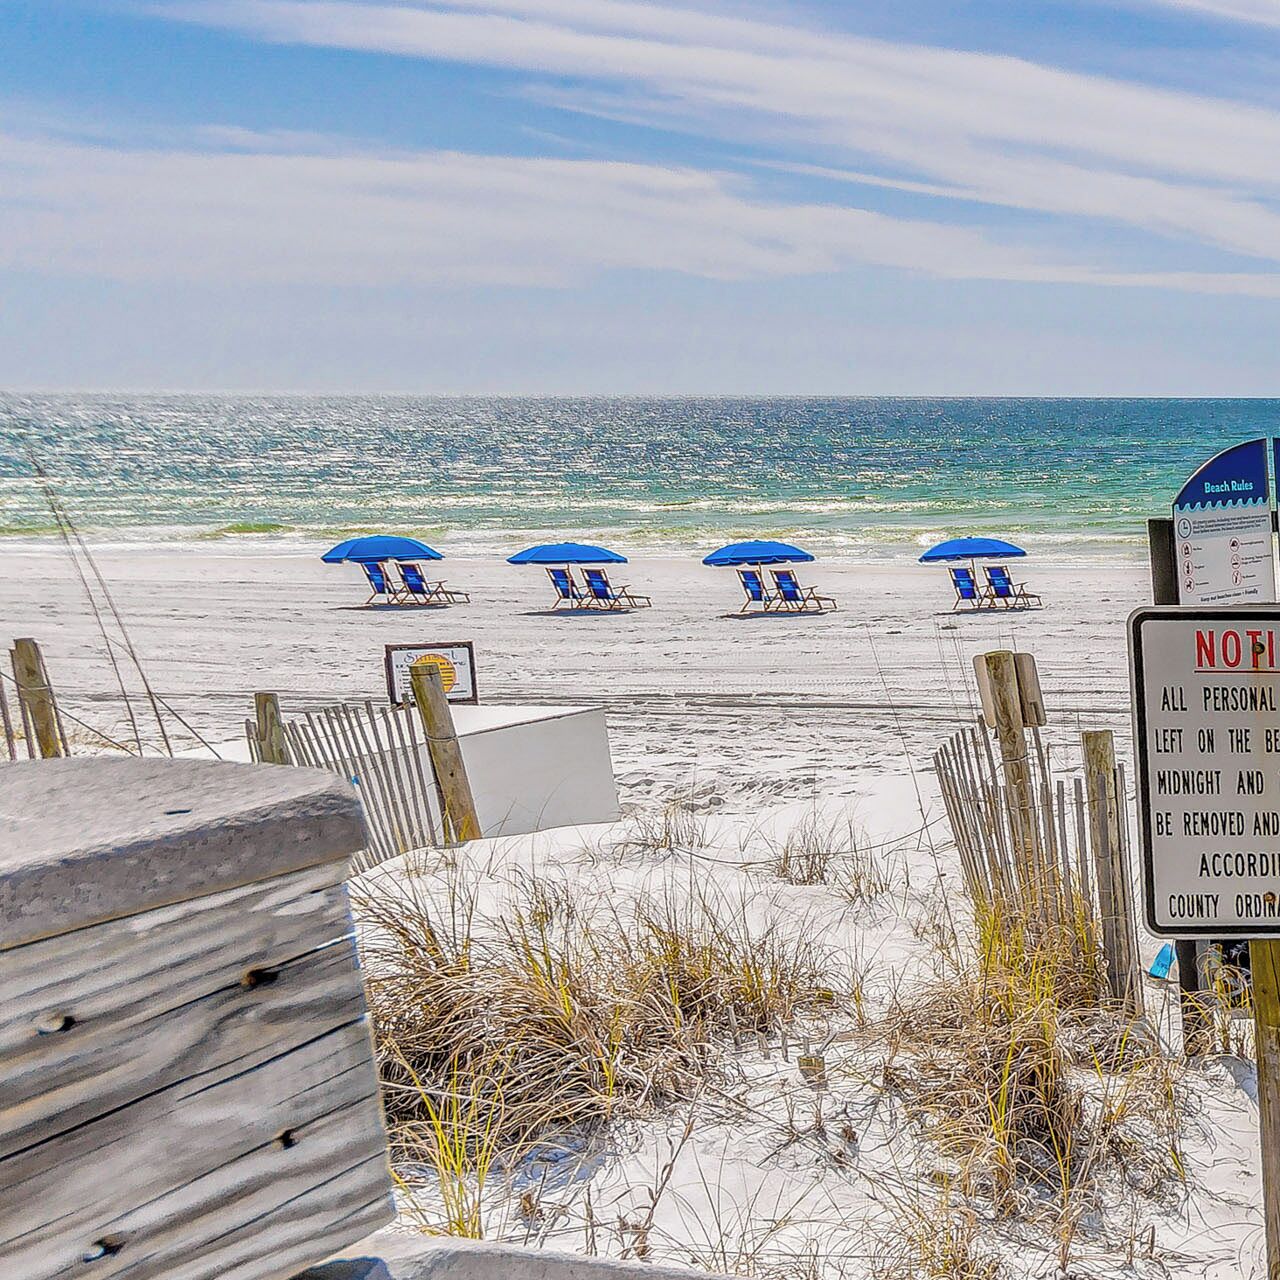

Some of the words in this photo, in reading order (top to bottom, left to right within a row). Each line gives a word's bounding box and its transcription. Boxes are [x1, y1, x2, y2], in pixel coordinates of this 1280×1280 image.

[1204, 480, 1230, 494] Beach
[1231, 479, 1254, 491] Rules
[1161, 686, 1188, 712] ALL
[1202, 686, 1277, 712] PERSONAL
[1154, 728, 1183, 754] LEFT
[1197, 728, 1215, 754] ON
[1227, 728, 1252, 754] THE
[1157, 770, 1222, 795] MIDNIGHT
[1236, 770, 1264, 795] AND
[1155, 812, 1173, 837] BE
[1183, 811, 1245, 837] REMOVED
[1252, 811, 1280, 837] AND
[1168, 894, 1220, 919] COUNTY
